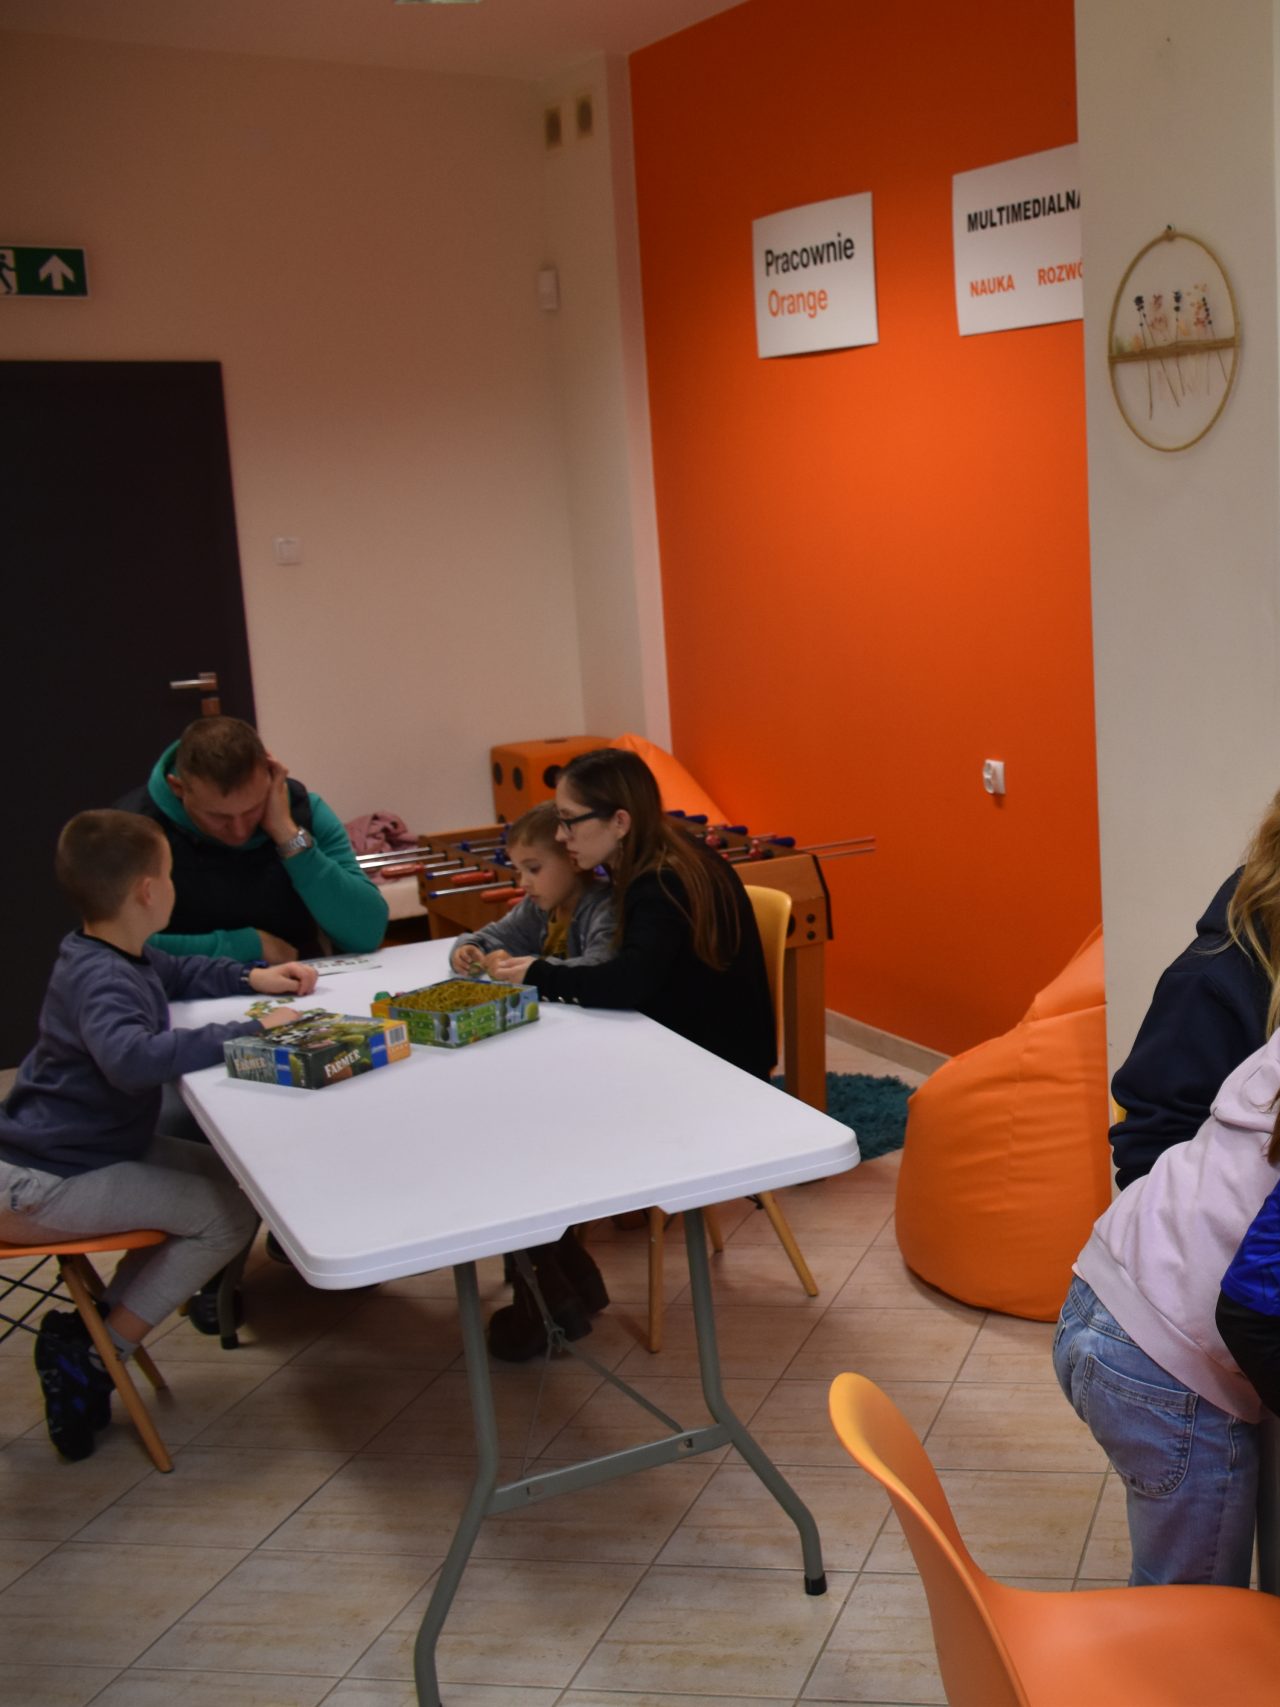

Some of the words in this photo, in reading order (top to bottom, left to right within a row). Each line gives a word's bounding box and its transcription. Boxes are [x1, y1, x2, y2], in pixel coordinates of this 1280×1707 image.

[764, 232, 855, 277] Pracownie
[969, 274, 1015, 298] NAUKA
[768, 289, 828, 318] Orange
[324, 1049, 361, 1078] FARMER
